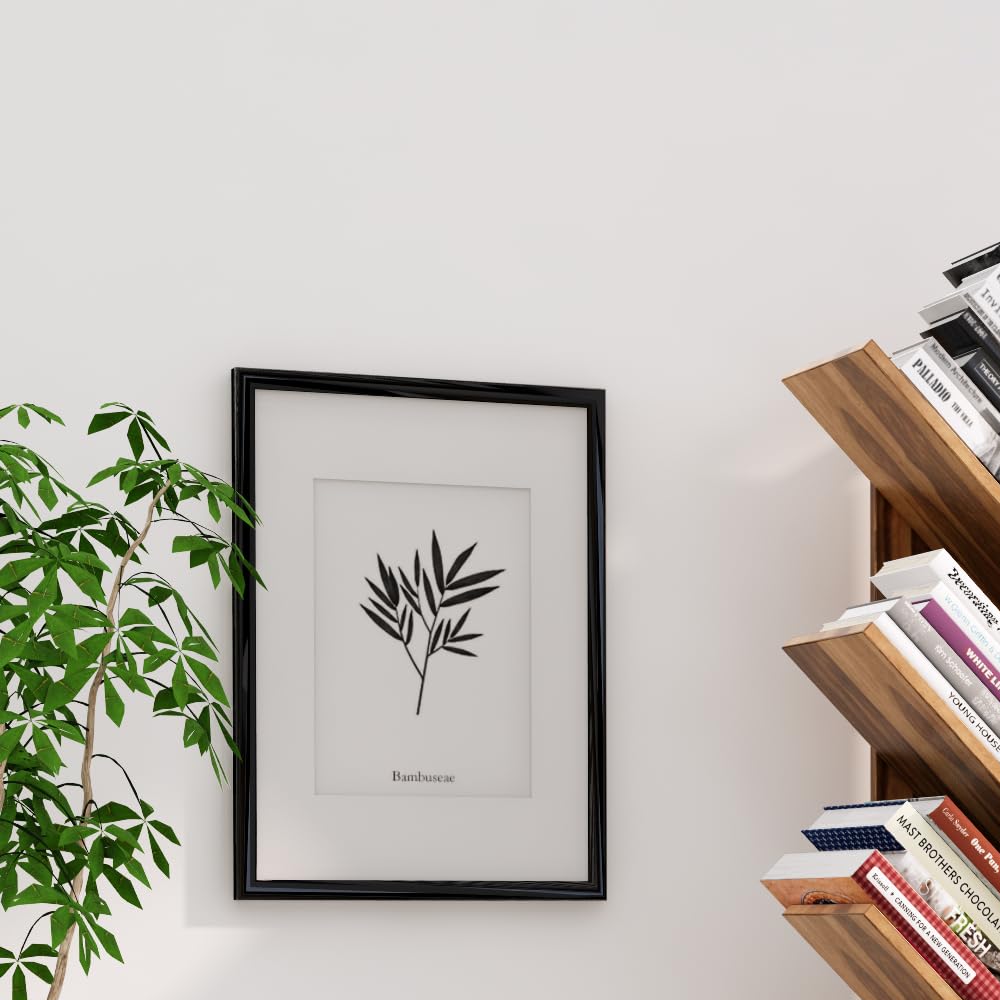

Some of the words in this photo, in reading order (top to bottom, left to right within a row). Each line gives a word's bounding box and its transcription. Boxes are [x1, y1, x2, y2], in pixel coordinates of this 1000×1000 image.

[912, 357, 952, 403] PALLADIO
[979, 363, 1000, 386] THEORY
[947, 567, 999, 629] Decorating
[964, 647, 992, 681] WHITE
[948, 691, 976, 724] YOUNG
[392, 770, 456, 783] Bambuseae
[896, 814, 922, 841] MAST
[917, 837, 962, 886] BROTHERS
[942, 806, 956, 824] Carla
[951, 817, 971, 840] Snyder
[970, 836, 987, 857] One
[983, 850, 1000, 875] Pan,
[894, 896, 918, 922] CANNING
[915, 919, 928, 933] FOR
[929, 934, 943, 948] NEW
[941, 944, 972, 980] GENERATION
[943, 904, 992, 958] FRESH
